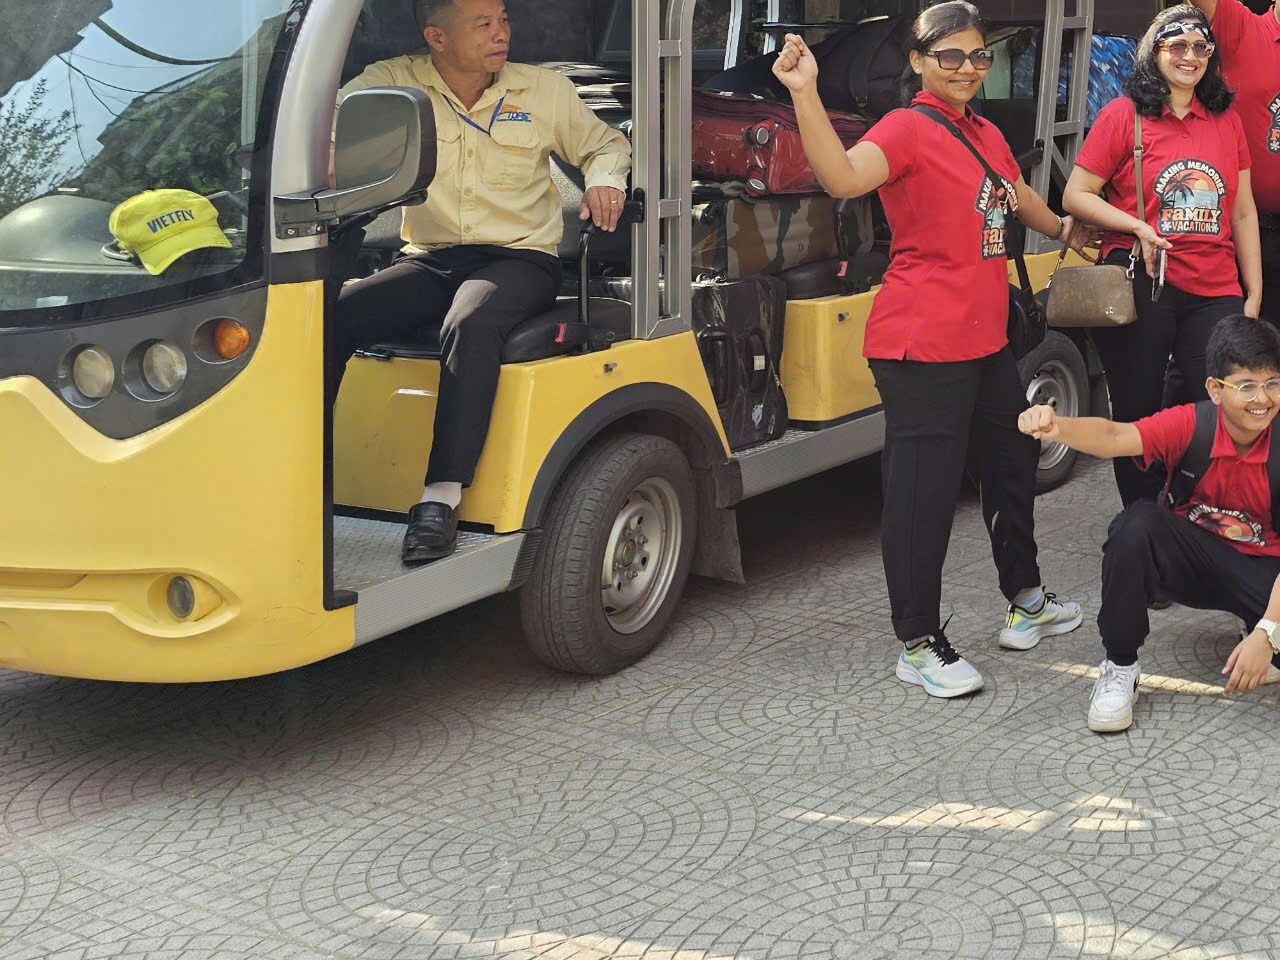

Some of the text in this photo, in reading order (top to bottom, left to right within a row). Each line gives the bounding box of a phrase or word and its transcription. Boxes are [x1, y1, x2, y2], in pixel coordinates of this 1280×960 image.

[1155, 160, 1225, 195] MAKING MEMORIES
[146, 209, 196, 234] VIETFLY
[1171, 220, 1212, 233] VACATION
